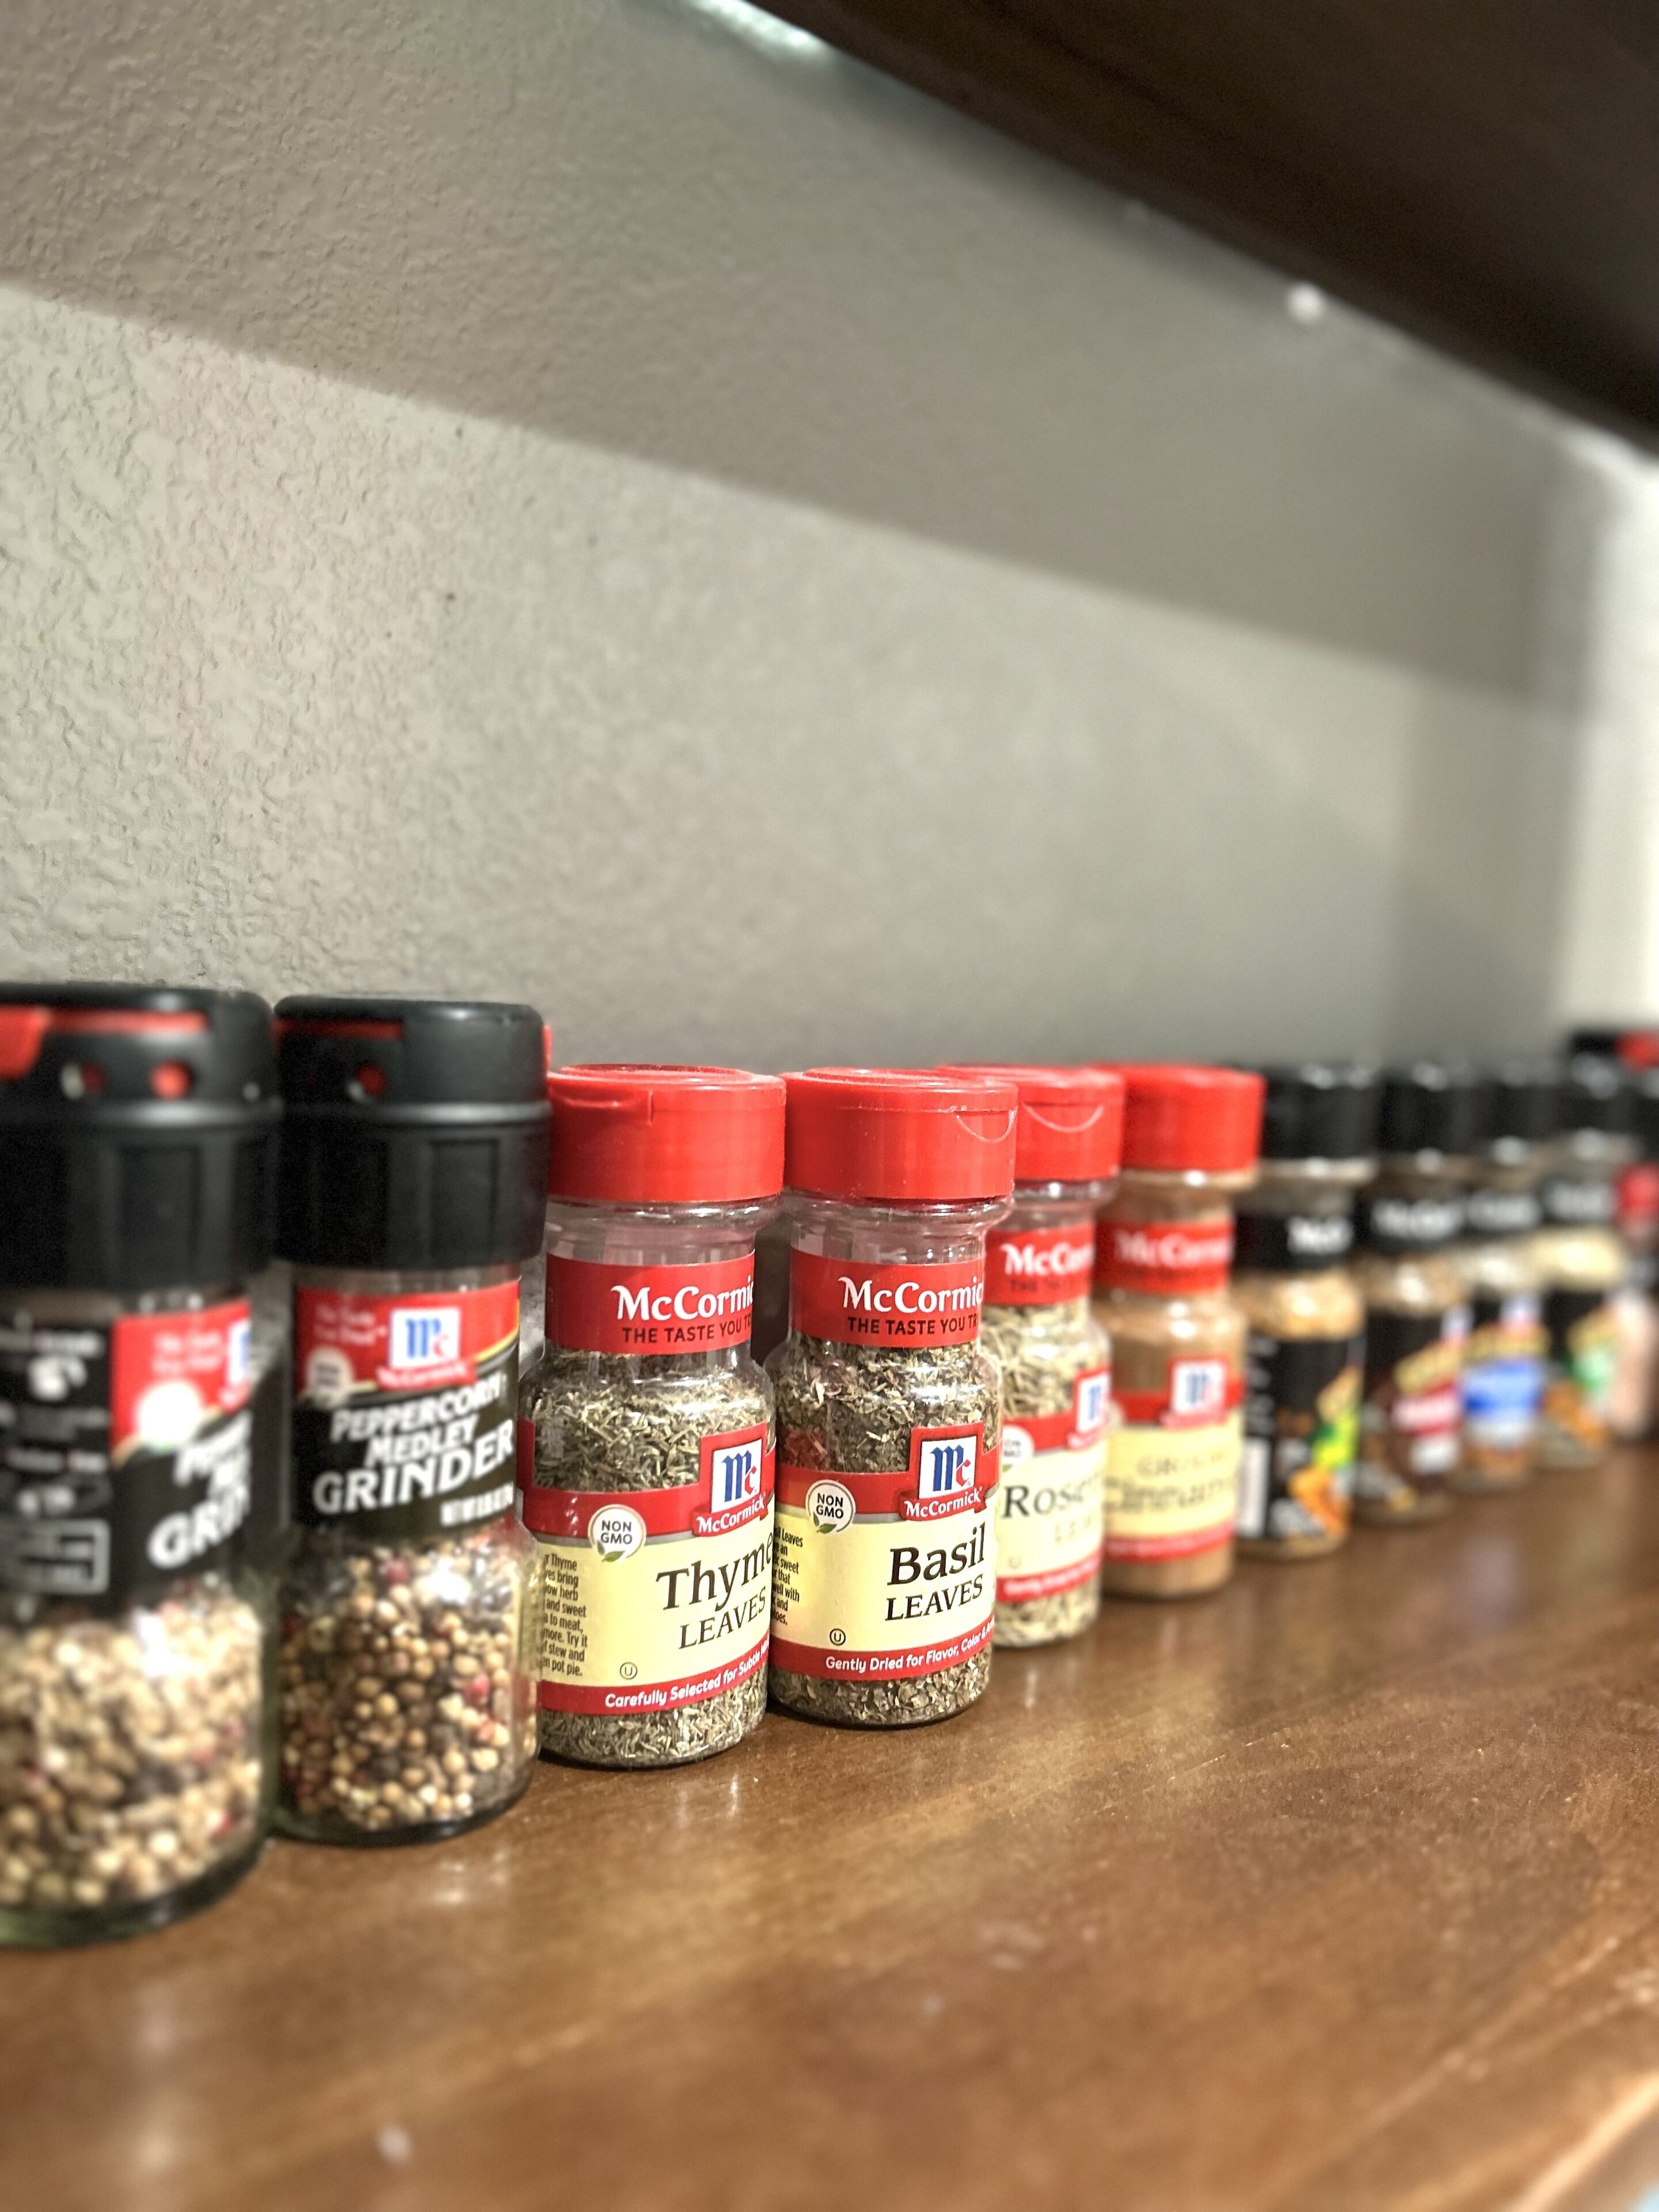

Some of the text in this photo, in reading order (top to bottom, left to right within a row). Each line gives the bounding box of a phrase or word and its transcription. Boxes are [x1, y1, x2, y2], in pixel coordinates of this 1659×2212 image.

[622, 1326, 657, 1343] THE
[664, 1323, 715, 1343] TASTE
[719, 1317, 743, 1338] YOU
[848, 1316, 880, 1334] THE
[885, 1319, 935, 1335] TASTE
[940, 1316, 964, 1334] YOU
[364, 1412, 479, 1469] MEDLEY
[312, 1419, 514, 1514] GRINDER
[817, 1492, 843, 1508] NON
[903, 1487, 981, 1518] McCormick
[696, 1493, 765, 1533] McCormick
[816, 1505, 844, 1519] GMO
[600, 1520, 632, 1532] NON
[600, 1532, 633, 1546] GMO
[782, 1527, 804, 1548] Leaves
[780, 1544, 788, 1556] an
[887, 1521, 986, 1587] Basil
[551, 1553, 578, 1571] Thyme
[656, 1530, 773, 1612] Thyme
[781, 1558, 800, 1575] sweet
[558, 1570, 579, 1589] bring
[778, 1569, 791, 1585] that
[560, 1585, 579, 1601] herb
[785, 1587, 800, 1603] with
[884, 1574, 983, 1621] LEAVES
[546, 1598, 587, 1618] and sweet
[777, 1598, 789, 1612] and
[550, 1612, 558, 1626] to
[559, 1616, 584, 1635] meat,
[679, 1585, 766, 1650] LEAVES
[566, 1631, 579, 1648] Try
[581, 1634, 588, 1648] it
[548, 1643, 567, 1658] stew
[568, 1649, 585, 1662] and
[825, 1656, 866, 1673] Gently
[869, 1656, 904, 1671] Dried
[906, 1654, 924, 1667] for
[925, 1645, 960, 1665] Flavor,
[961, 1632, 982, 1653] Color
[552, 1660, 565, 1673] pot
[566, 1662, 583, 1676] pie.
[604, 1689, 667, 1708] Carefully
[669, 1672, 721, 1700] Selected
[722, 1667, 738, 1685] for
